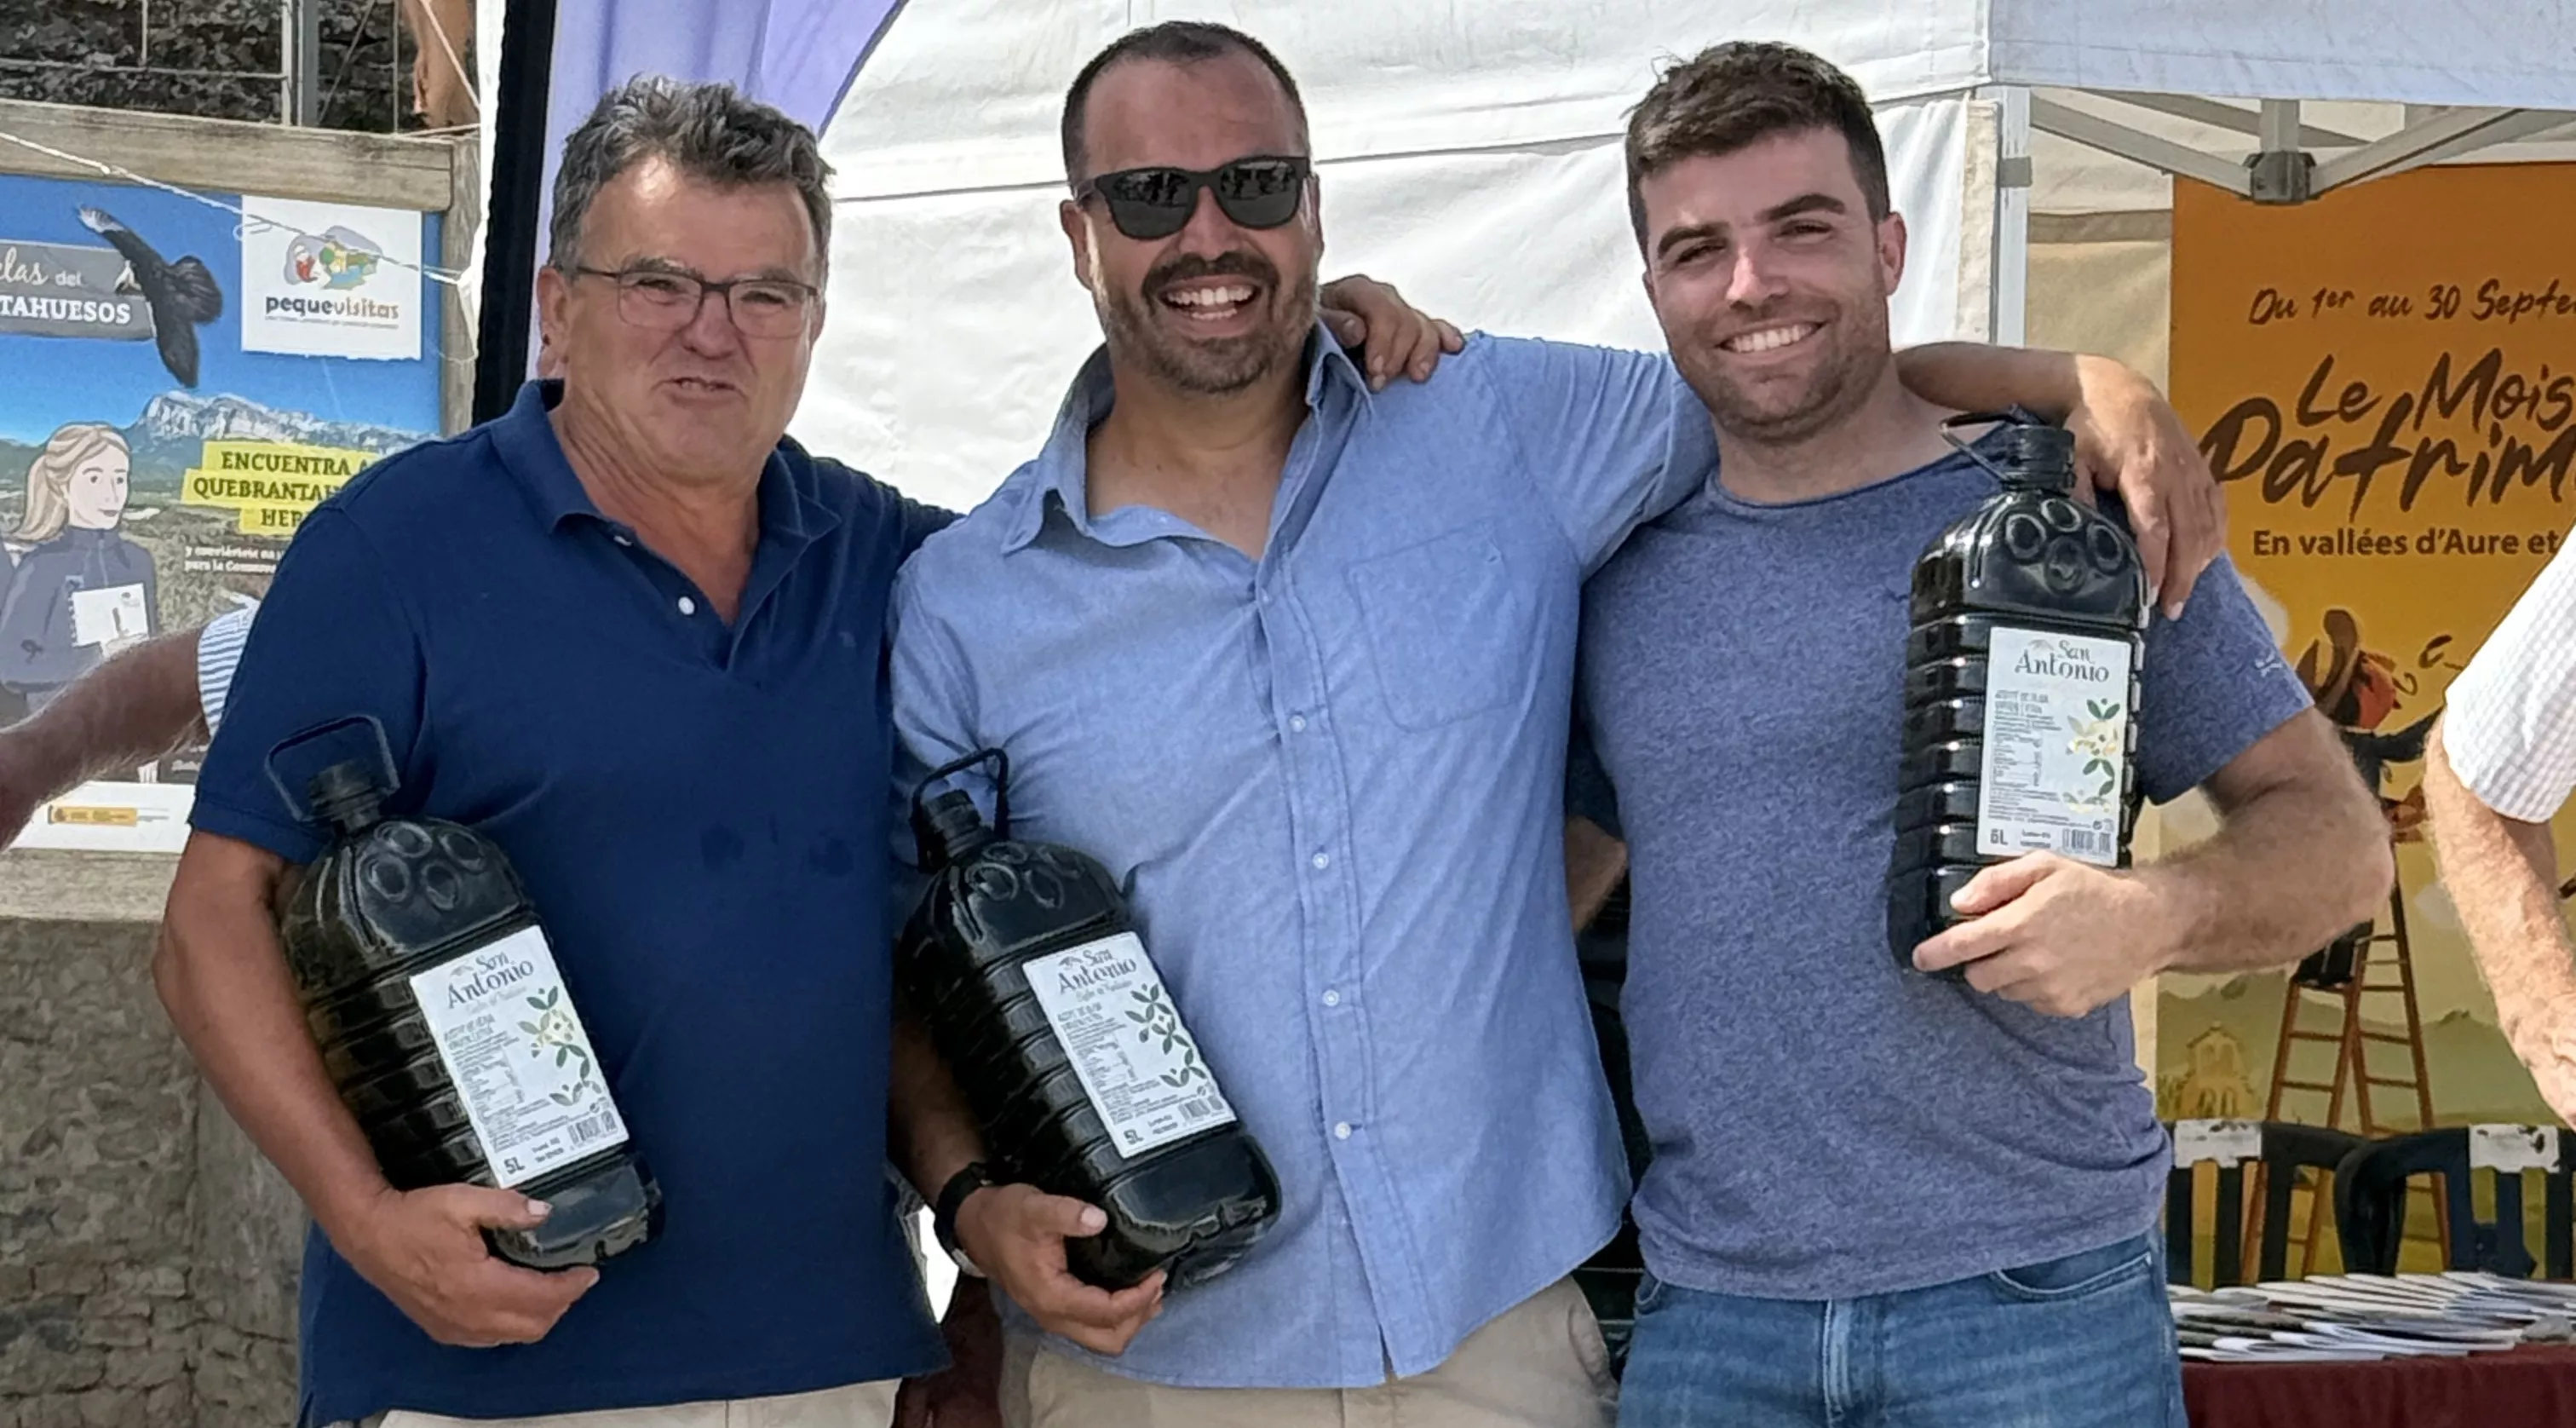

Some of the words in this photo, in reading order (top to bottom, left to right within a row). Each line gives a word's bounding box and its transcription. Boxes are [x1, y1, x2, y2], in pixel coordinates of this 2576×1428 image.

[0, 245, 49, 286] las
[55, 270, 83, 287] del
[0, 294, 131, 325] TAHUESOS
[266, 296, 399, 320] pequevisitas
[2311, 287, 2355, 319] 1er
[2368, 295, 2413, 318] au
[2424, 285, 2462, 320] 30
[2471, 279, 2576, 325] Septe
[2297, 354, 2383, 427] Le
[2412, 348, 2574, 432] Mois
[221, 452, 351, 475] ENCUENTRA
[2198, 392, 2576, 523] Patrim
[193, 477, 342, 501] QUEBRANTAH
[261, 508, 305, 527] HER
[2253, 531, 2290, 556] En
[2298, 527, 2408, 556] vallées
[2527, 530, 2559, 556] et
[2015, 649, 2110, 682] Antonio
[2058, 640, 2095, 664] San
[446, 960, 535, 1009] Antonio
[503, 1156, 526, 1175] 5L
